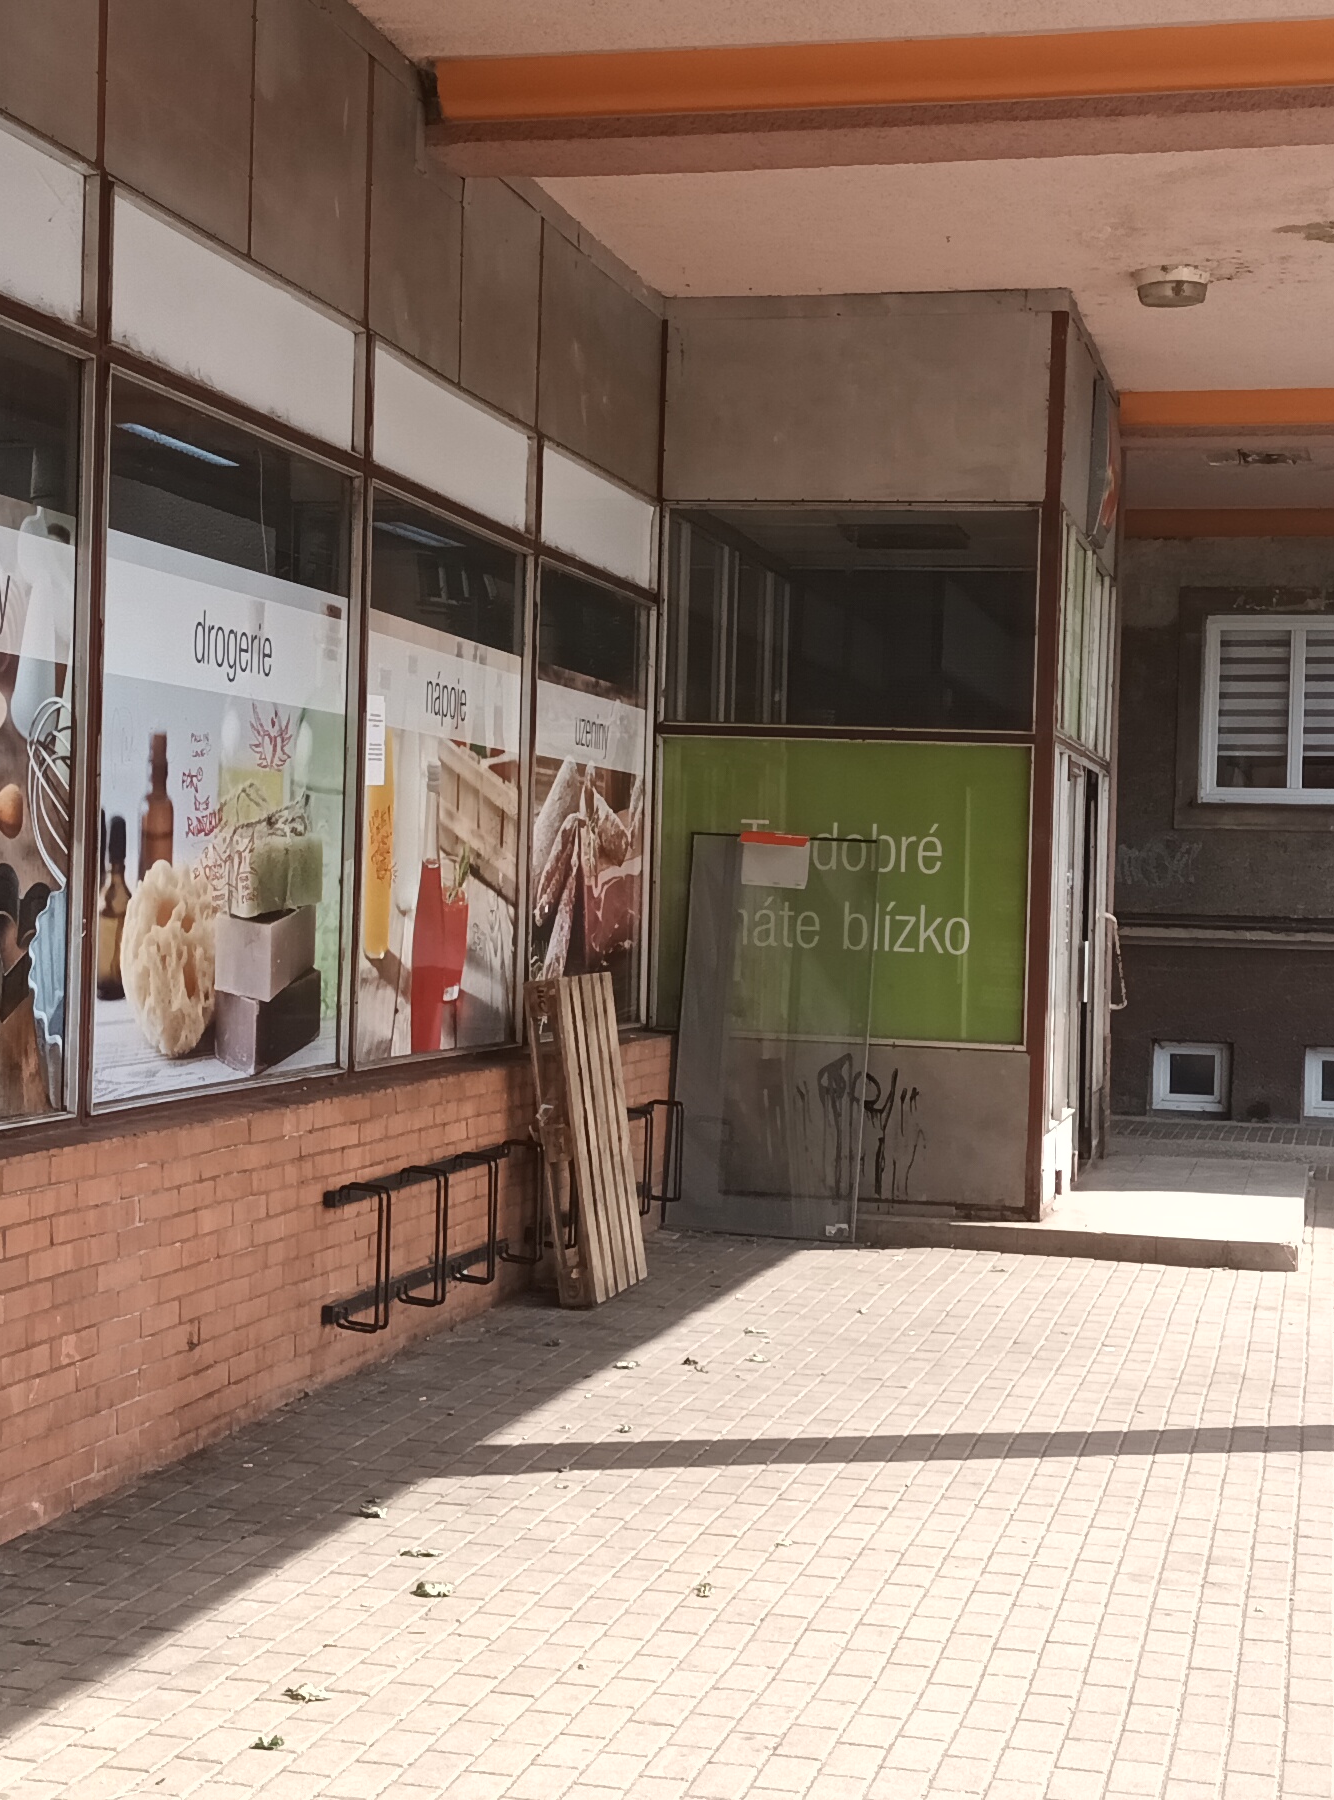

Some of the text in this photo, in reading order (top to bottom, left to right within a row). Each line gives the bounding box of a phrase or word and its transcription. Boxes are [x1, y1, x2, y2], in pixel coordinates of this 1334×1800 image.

[193, 609, 273, 683] drogerie
[425, 671, 468, 730] nápoje
[574, 713, 610, 760] uzeniny
[812, 822, 943, 875] dobré
[842, 900, 971, 956] blízko
